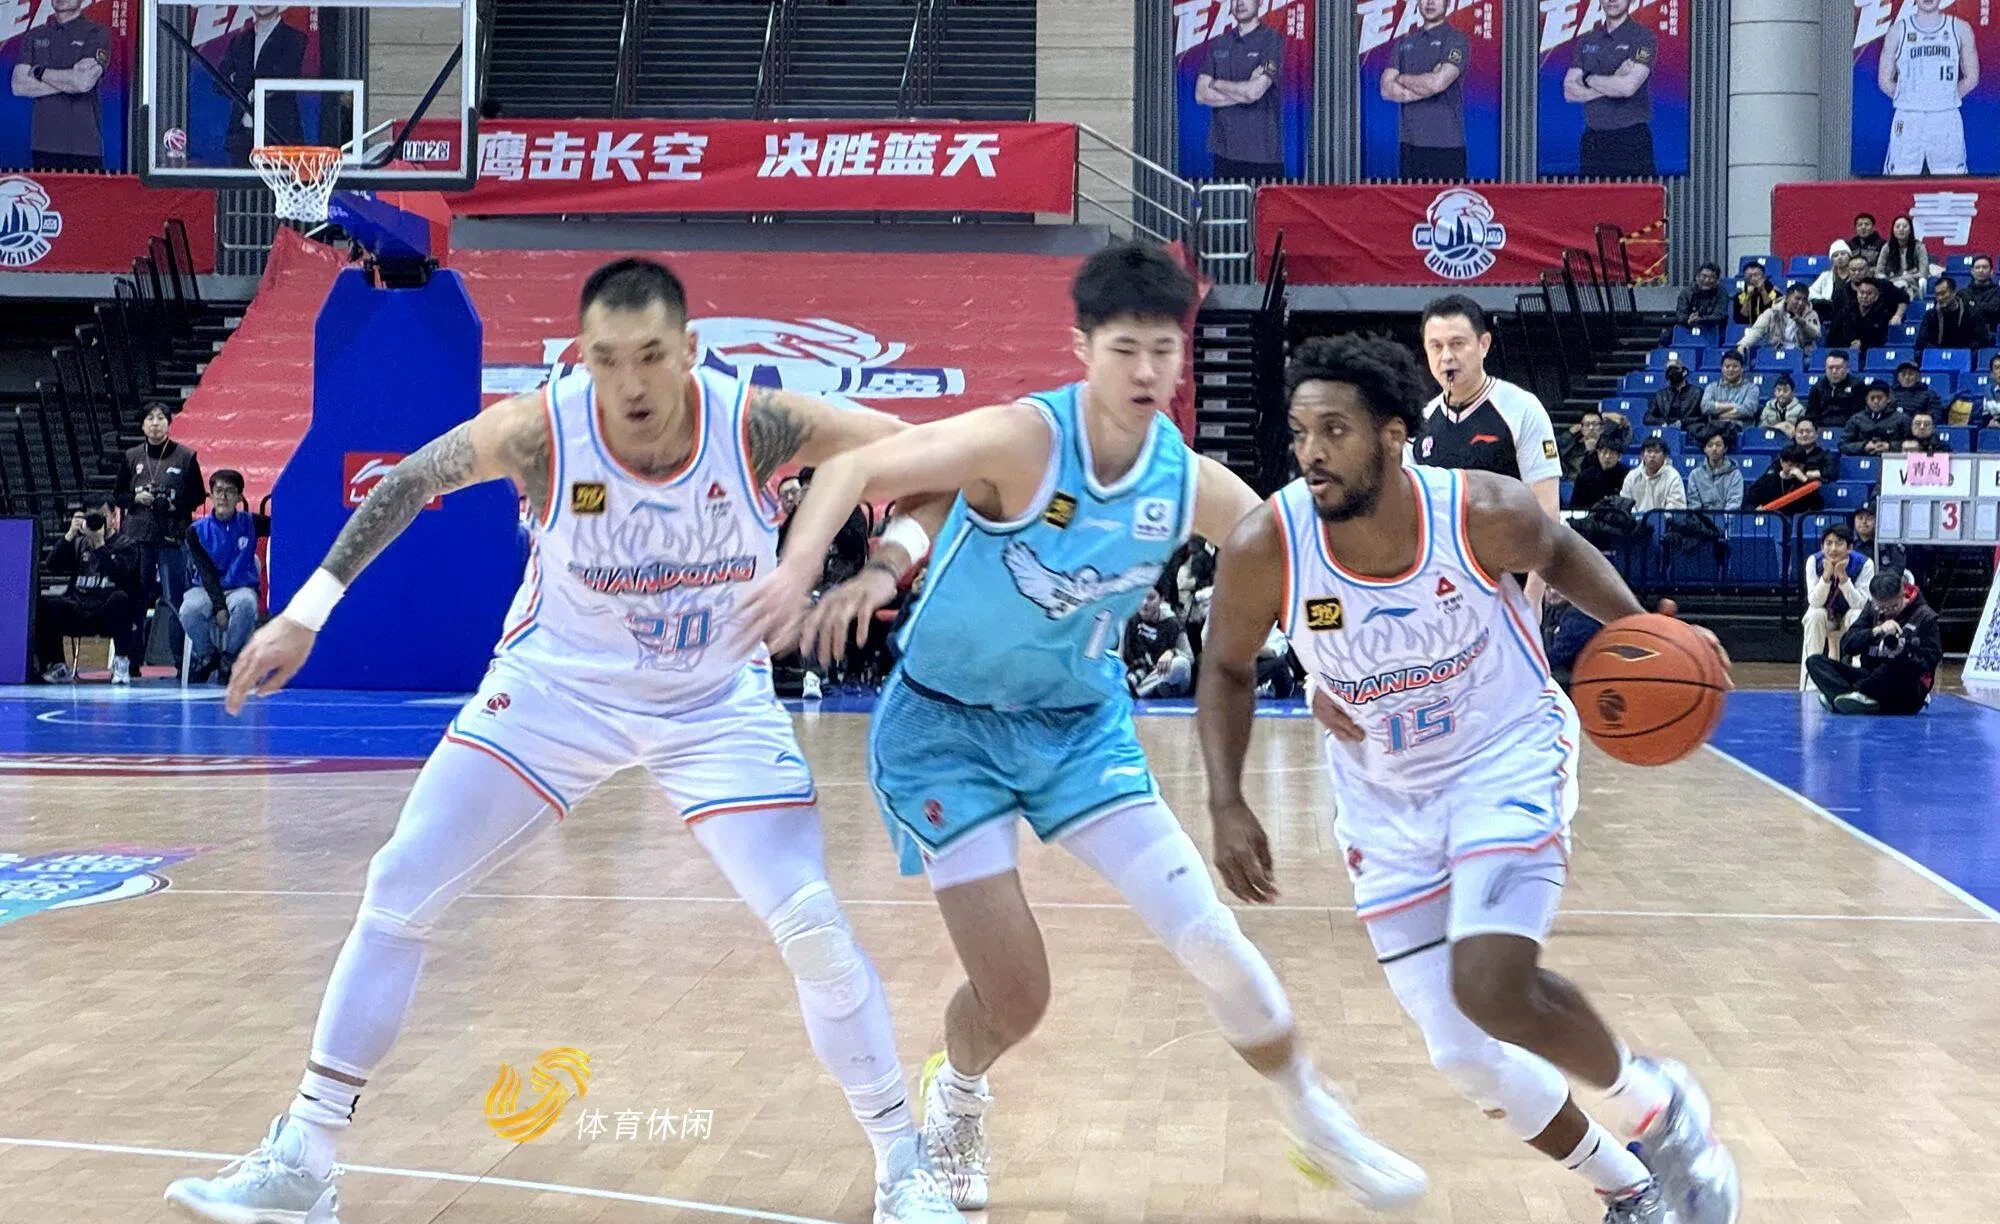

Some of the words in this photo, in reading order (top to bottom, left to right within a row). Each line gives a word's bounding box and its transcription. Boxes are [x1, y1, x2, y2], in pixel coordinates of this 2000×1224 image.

[1940, 65, 1954, 81] 15
[477, 131, 708, 182] 鹰击长空
[756, 132, 1000, 177] 决胜篮天
[1909, 191, 1979, 246] 青
[1428, 252, 1493, 278] QINGDAO
[1942, 502, 1958, 531] 3
[1381, 696, 1456, 756] 15
